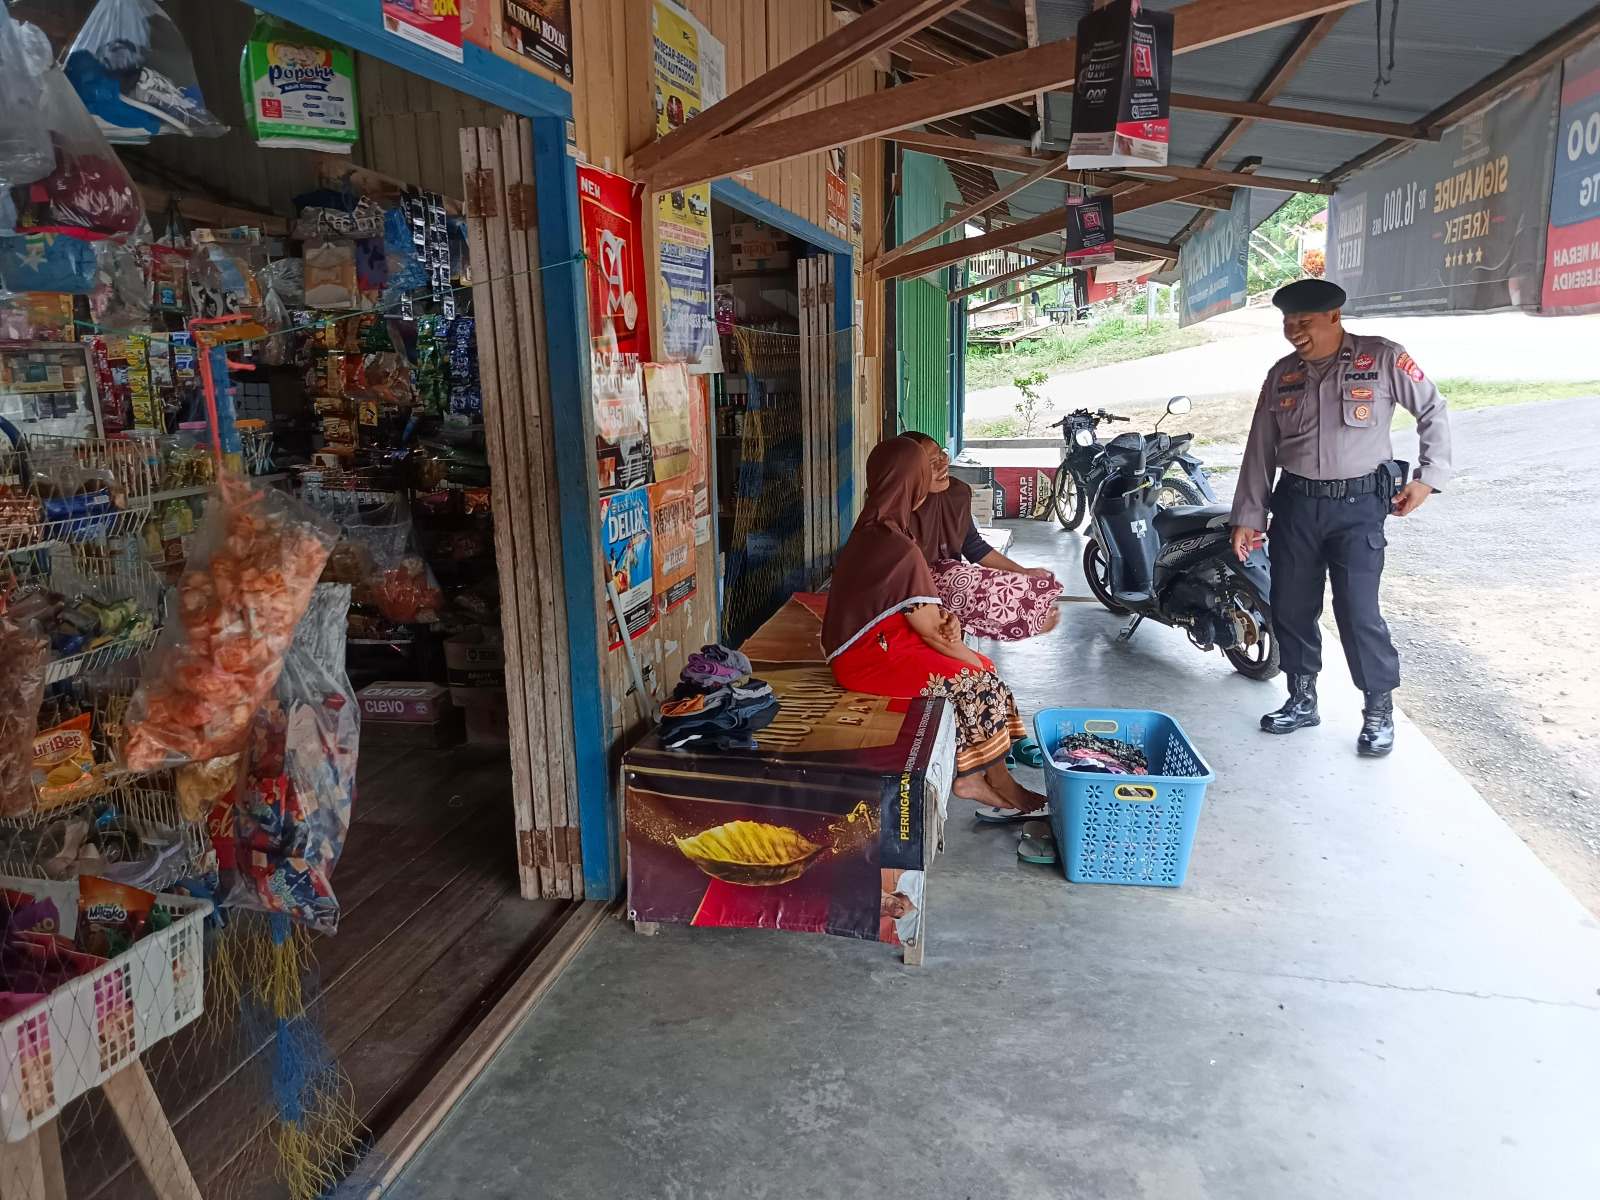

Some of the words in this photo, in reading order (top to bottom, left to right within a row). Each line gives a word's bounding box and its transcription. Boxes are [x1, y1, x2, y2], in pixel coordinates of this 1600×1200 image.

[506, 1, 541, 34] KURMA
[541, 20, 568, 51] ROYAL
[580, 176, 601, 199] NEW
[1344, 371, 1379, 382] POLRI
[654, 501, 680, 525] REGION
[995, 490, 1003, 517] BARU
[365, 700, 405, 713] CLEVO
